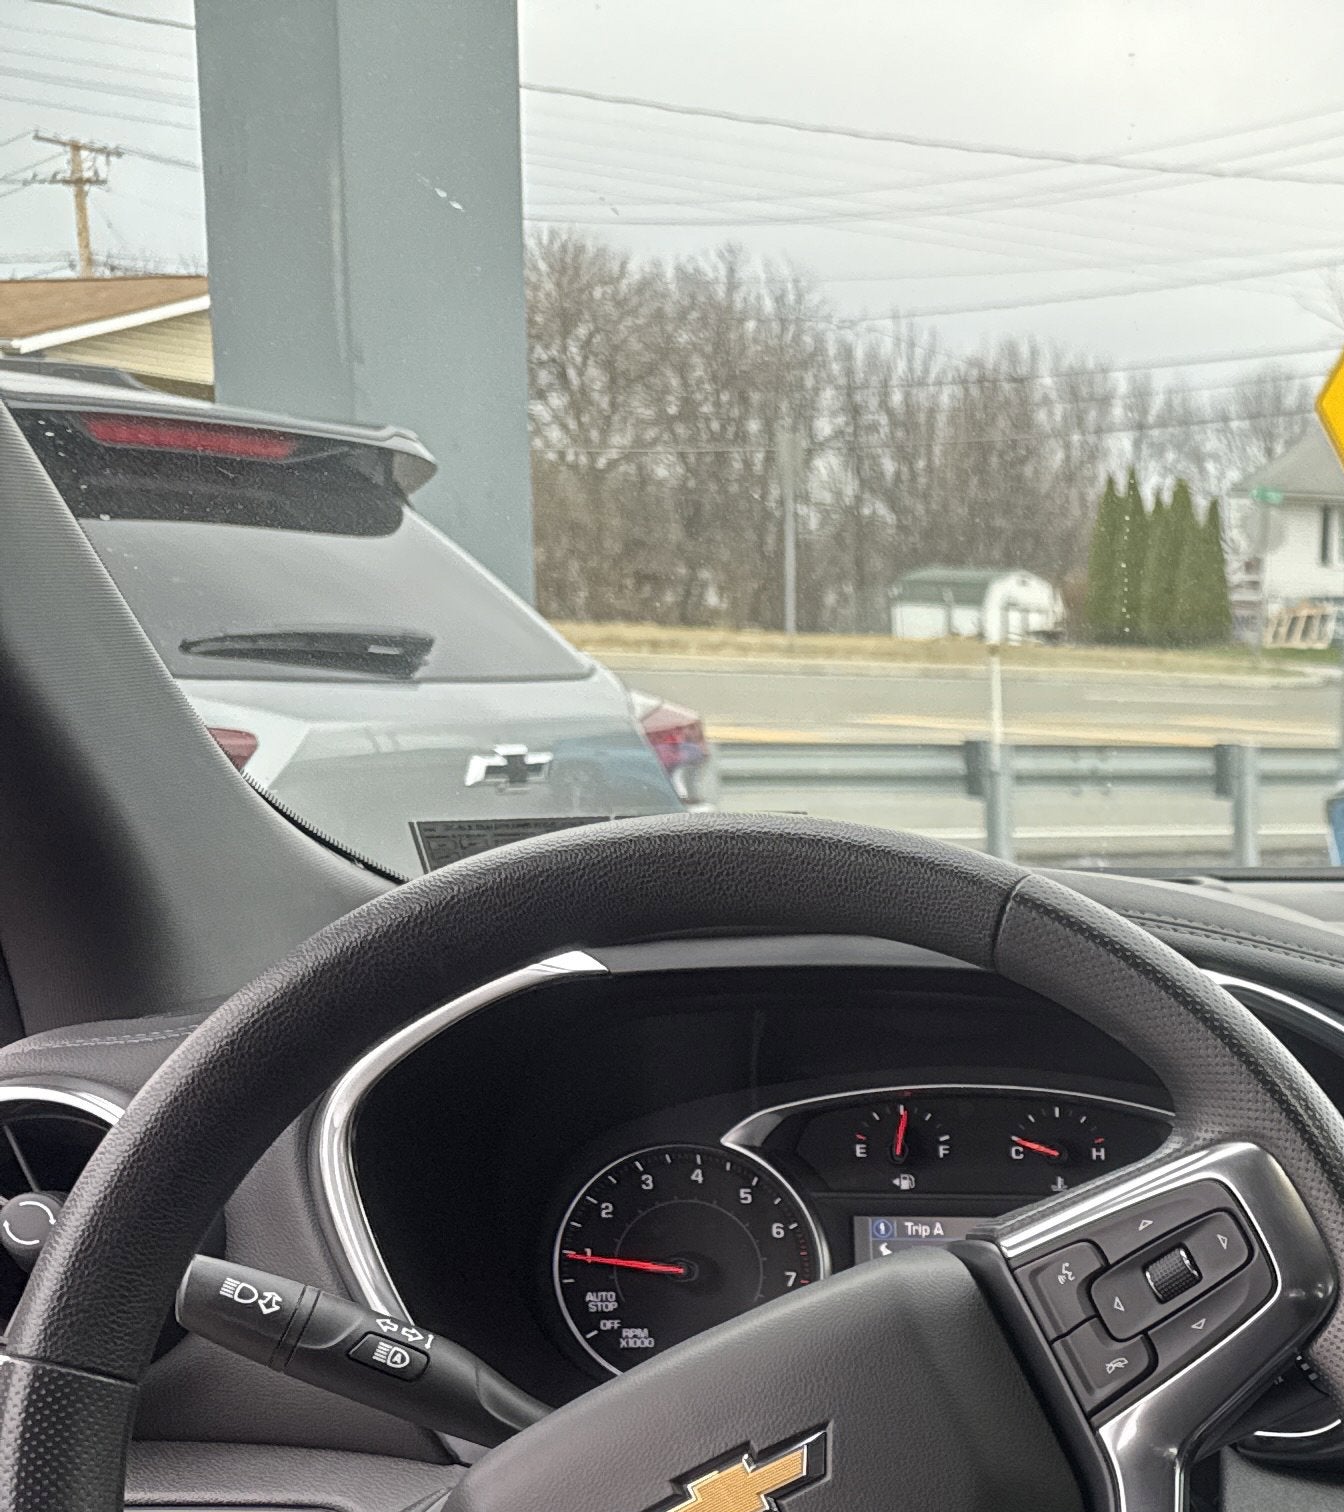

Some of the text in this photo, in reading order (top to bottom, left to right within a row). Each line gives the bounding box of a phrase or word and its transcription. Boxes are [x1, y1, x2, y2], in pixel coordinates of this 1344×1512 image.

[856, 1143, 867, 1158] E
[939, 1145, 950, 1159] F
[1011, 1146, 1024, 1160] C
[1092, 1147, 1105, 1161] H
[641, 1174, 653, 1190] 3
[691, 1169, 704, 1183] 4
[739, 1188, 752, 1204] 5
[600, 1203, 613, 1218] 2
[771, 1223, 785, 1238] 6
[904, 1222, 944, 1239] Trip A
[784, 1271, 797, 1287] 7
[586, 1292, 616, 1302] AUTO
[588, 1302, 618, 1312] STOP
[601, 1320, 622, 1331] OFF
[622, 1328, 649, 1339] RPM
[620, 1337, 655, 1349] X1000
